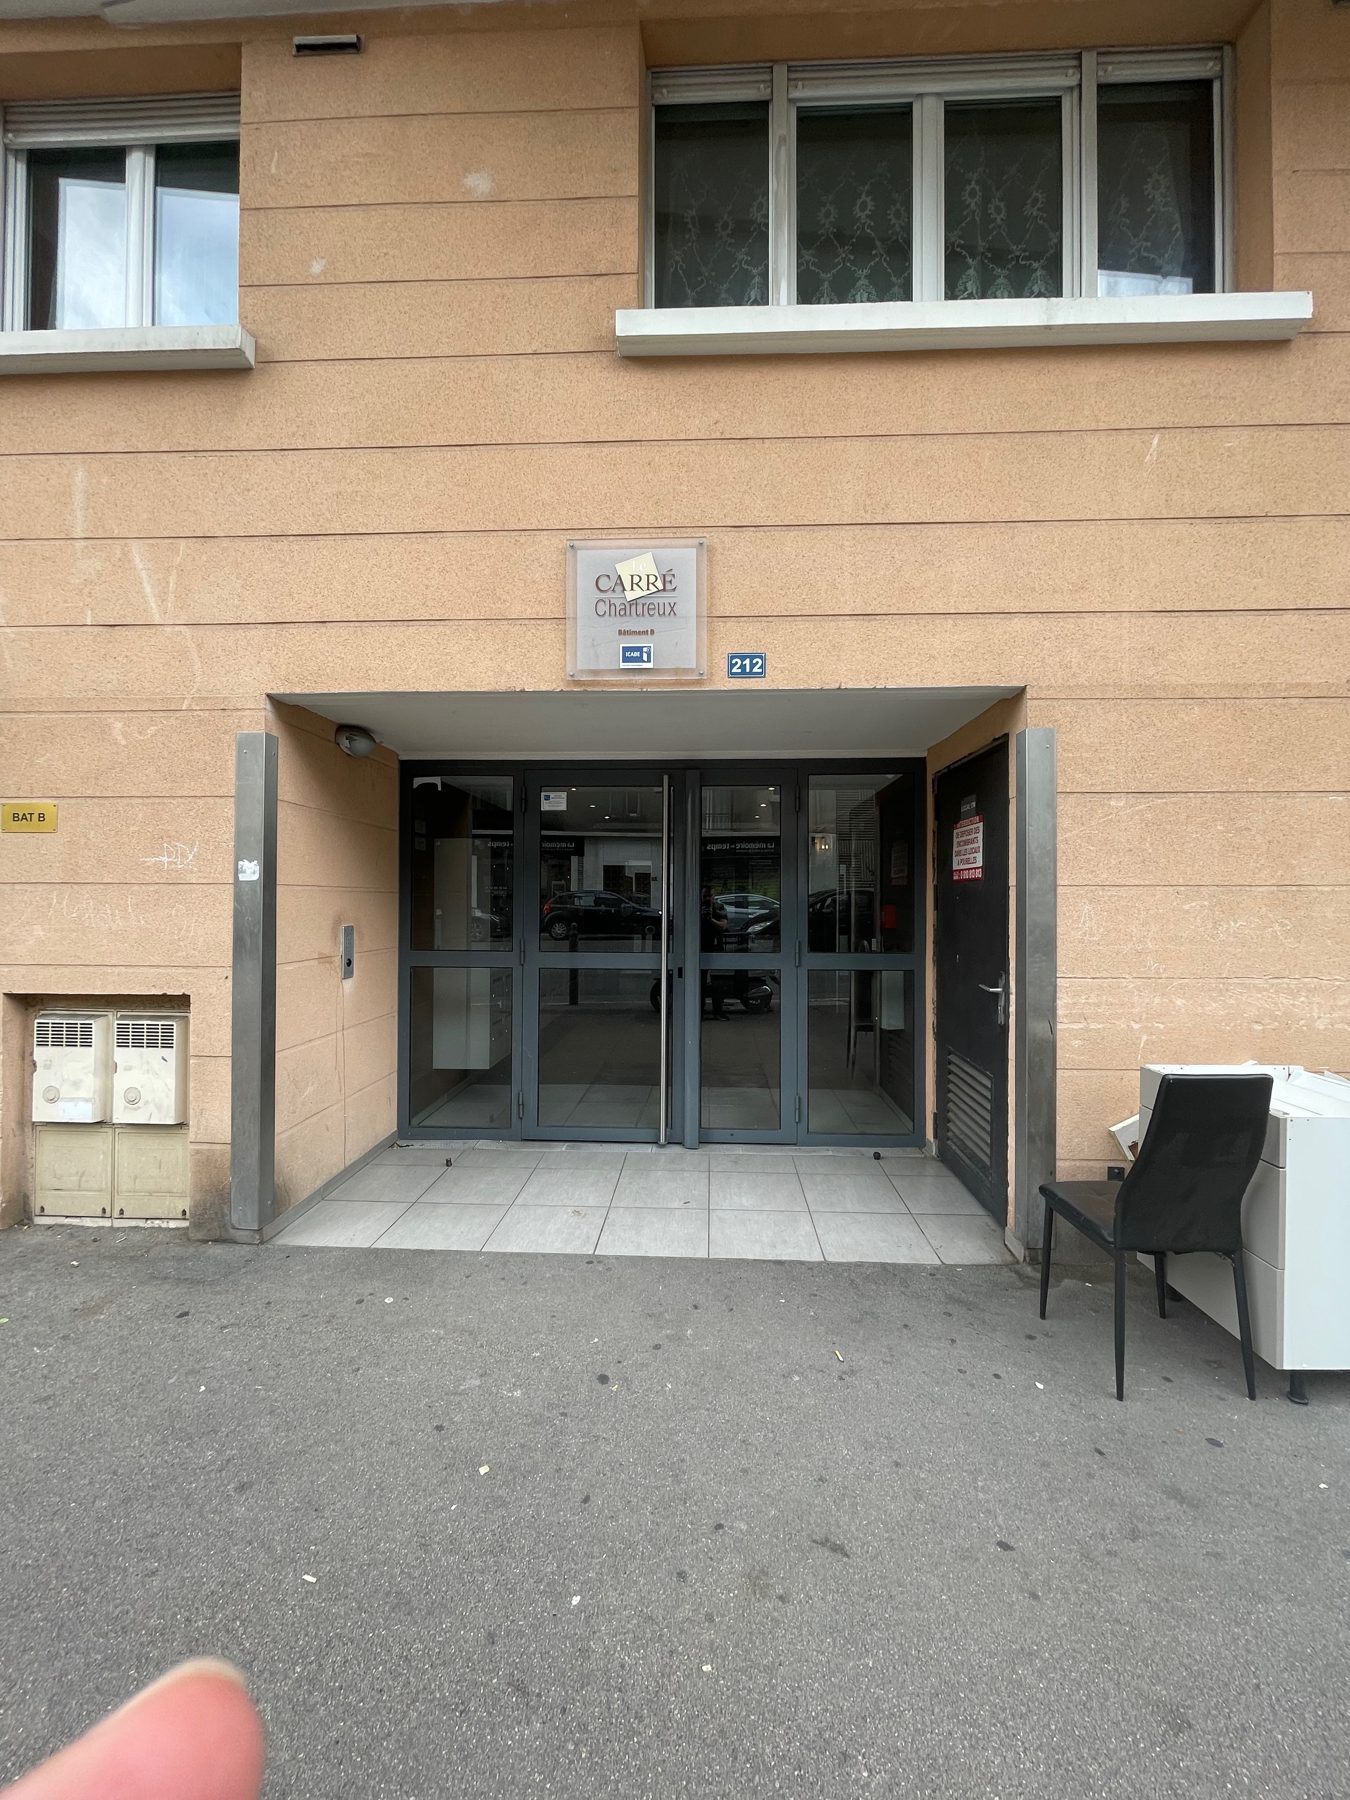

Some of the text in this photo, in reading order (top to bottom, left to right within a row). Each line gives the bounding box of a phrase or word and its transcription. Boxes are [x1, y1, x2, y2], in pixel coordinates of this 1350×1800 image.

[631, 559, 648, 572] Le
[595, 568, 678, 593] CARRÉ
[594, 598, 677, 618] Chartreux
[617, 628, 649, 636] Bâtiment
[731, 658, 763, 673] 212
[12, 812, 46, 822] BAT B
